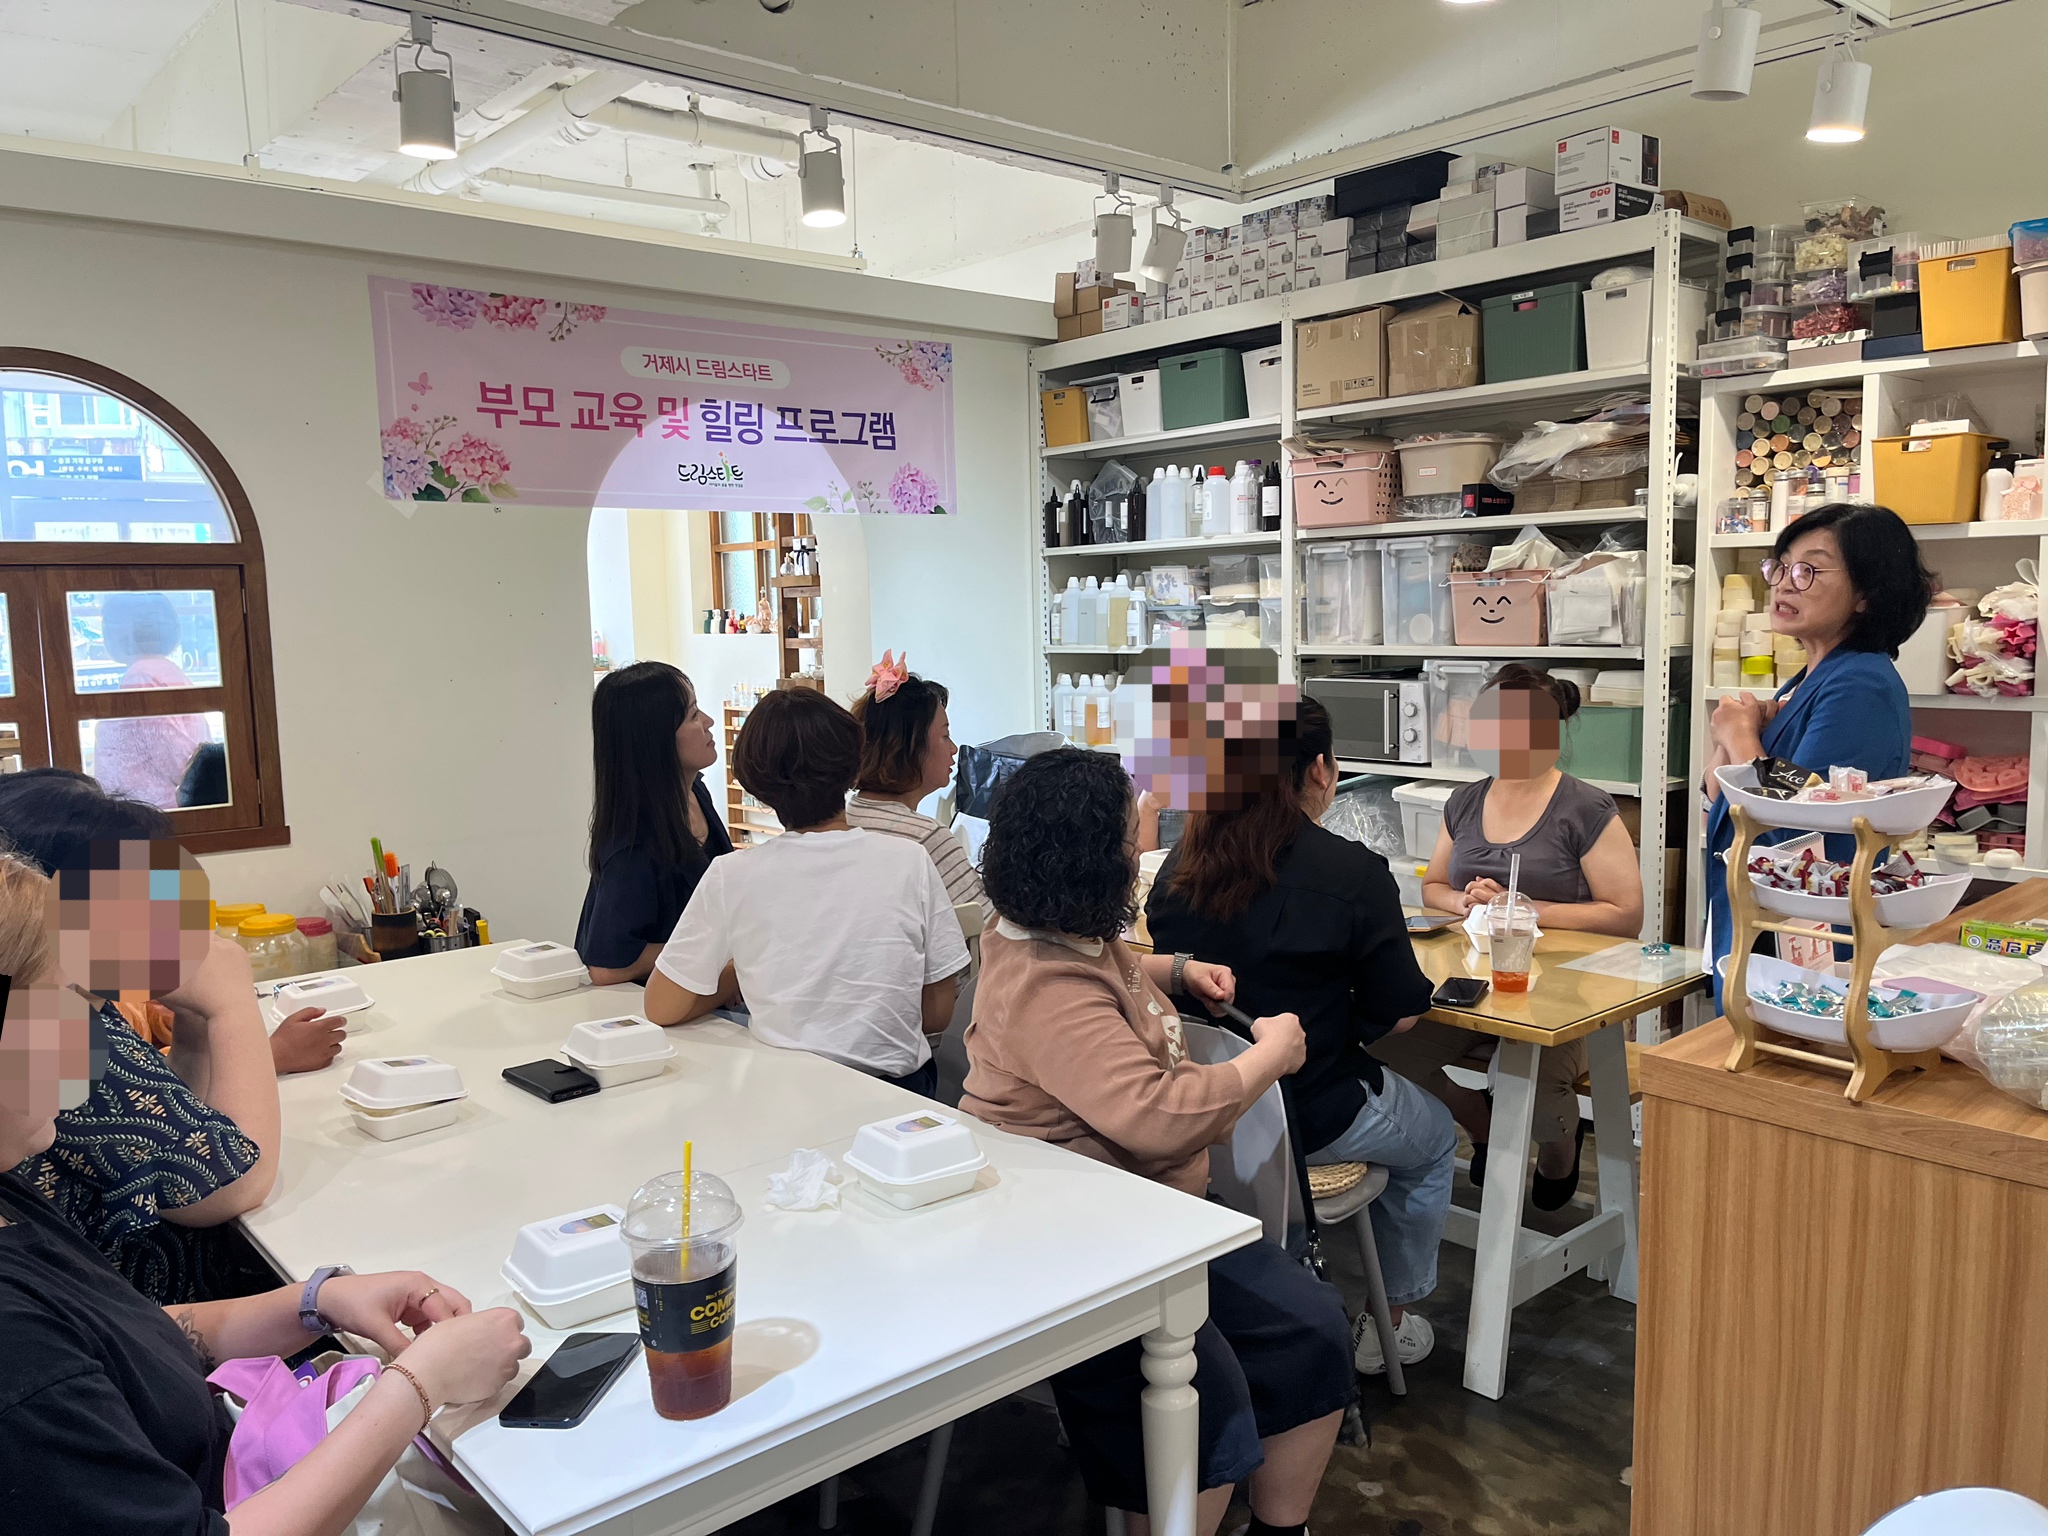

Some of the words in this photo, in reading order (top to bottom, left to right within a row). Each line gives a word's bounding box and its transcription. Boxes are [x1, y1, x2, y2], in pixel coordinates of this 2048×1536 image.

[642, 353, 691, 377] 거제시
[695, 357, 774, 383] 드림스타트
[476, 381, 561, 430] 부모
[570, 390, 648, 439] 교육
[657, 395, 691, 441] 및
[699, 398, 764, 446] 힐링
[773, 405, 898, 451] 프로그램
[678, 459, 744, 485] 드림스타트
[1769, 769, 1805, 785] Ace
[690, 1291, 735, 1321] COMP
